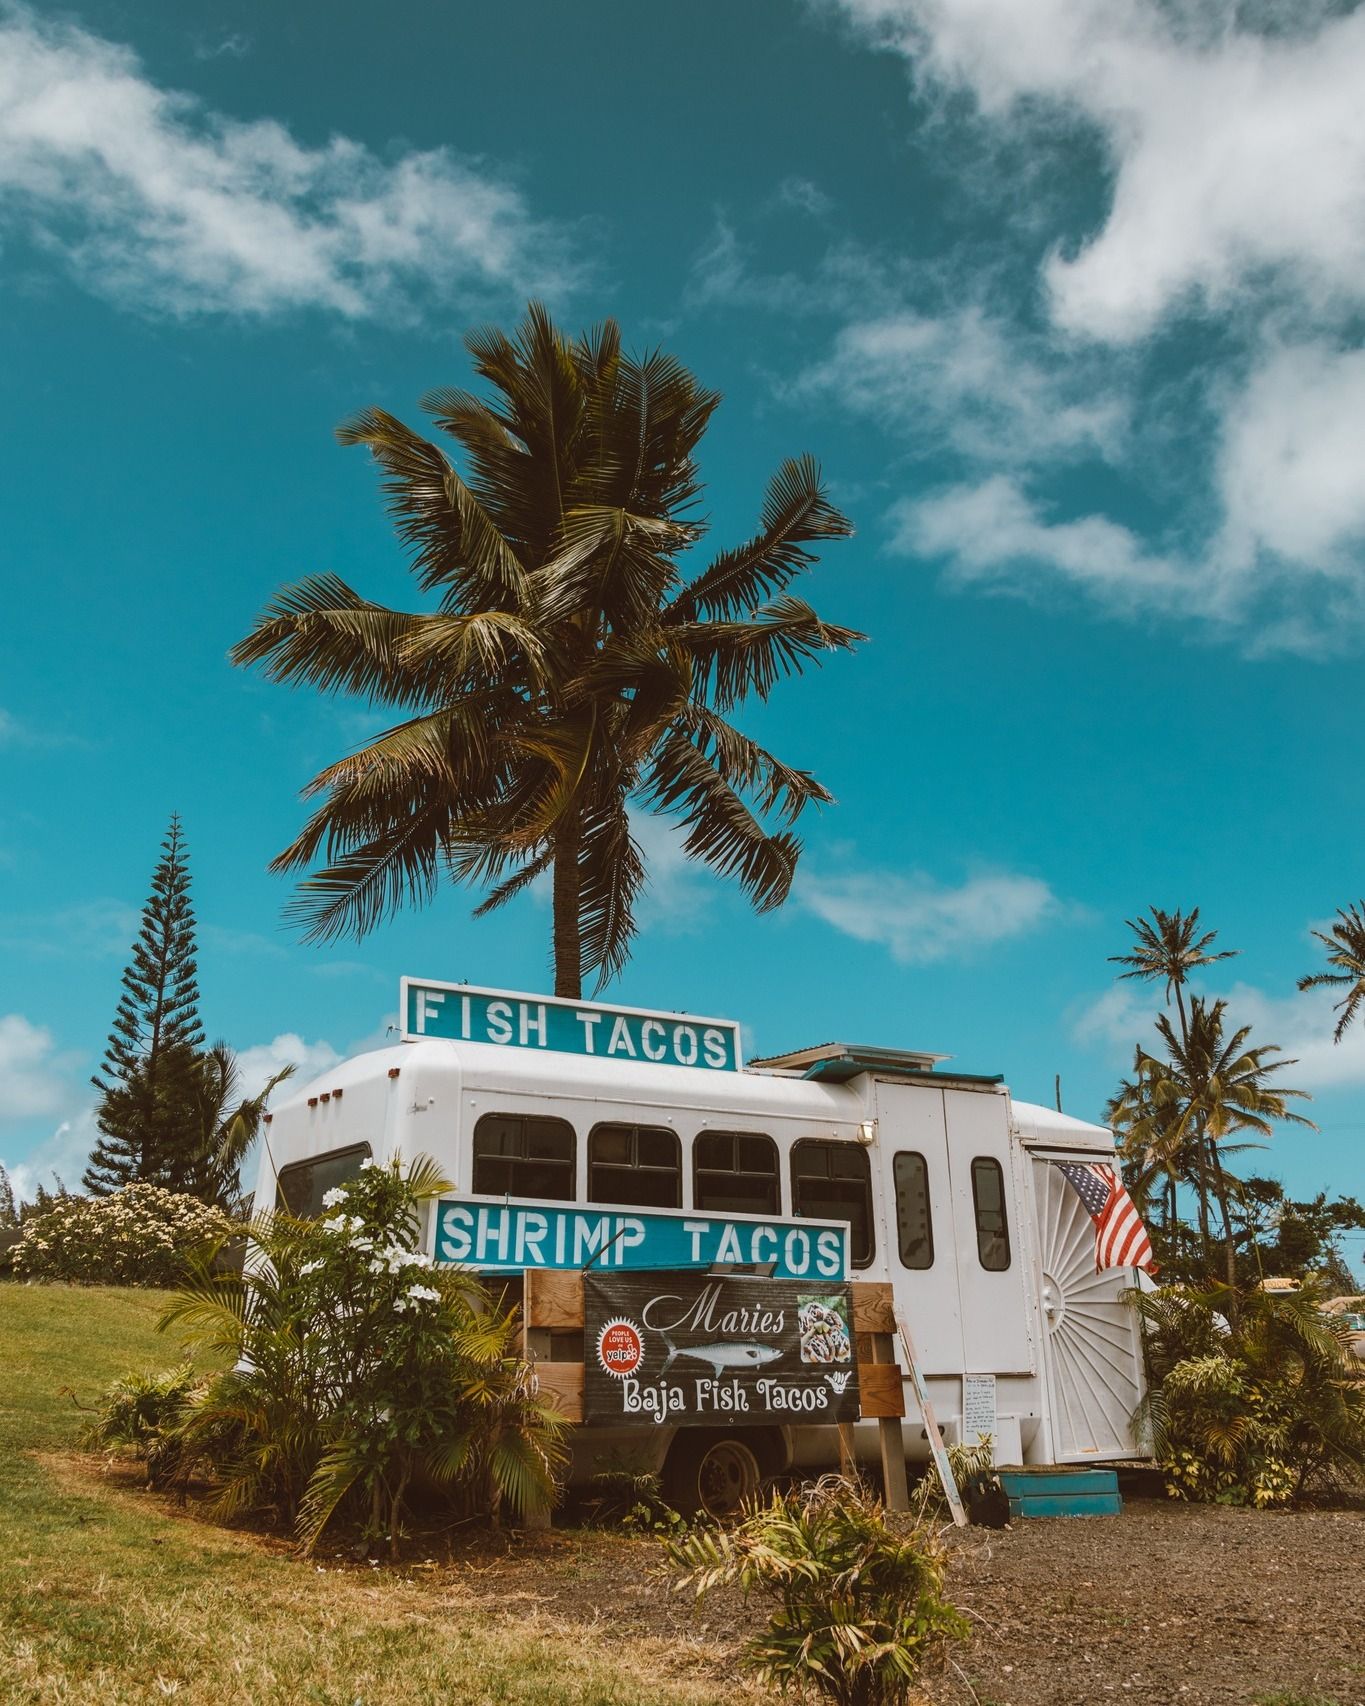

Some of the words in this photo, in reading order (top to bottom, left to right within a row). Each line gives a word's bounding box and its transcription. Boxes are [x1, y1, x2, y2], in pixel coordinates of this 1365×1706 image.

[416, 990, 547, 1047] FISH
[576, 1012, 727, 1068] TACOS
[441, 1207, 645, 1265] SHRIMP
[684, 1221, 841, 1277] TACOS
[642, 1283, 785, 1334] Maries
[607, 1349, 628, 1362] yelp
[622, 1378, 687, 1424] Baja
[695, 1378, 750, 1412] Fish
[756, 1378, 829, 1411] Tacos
